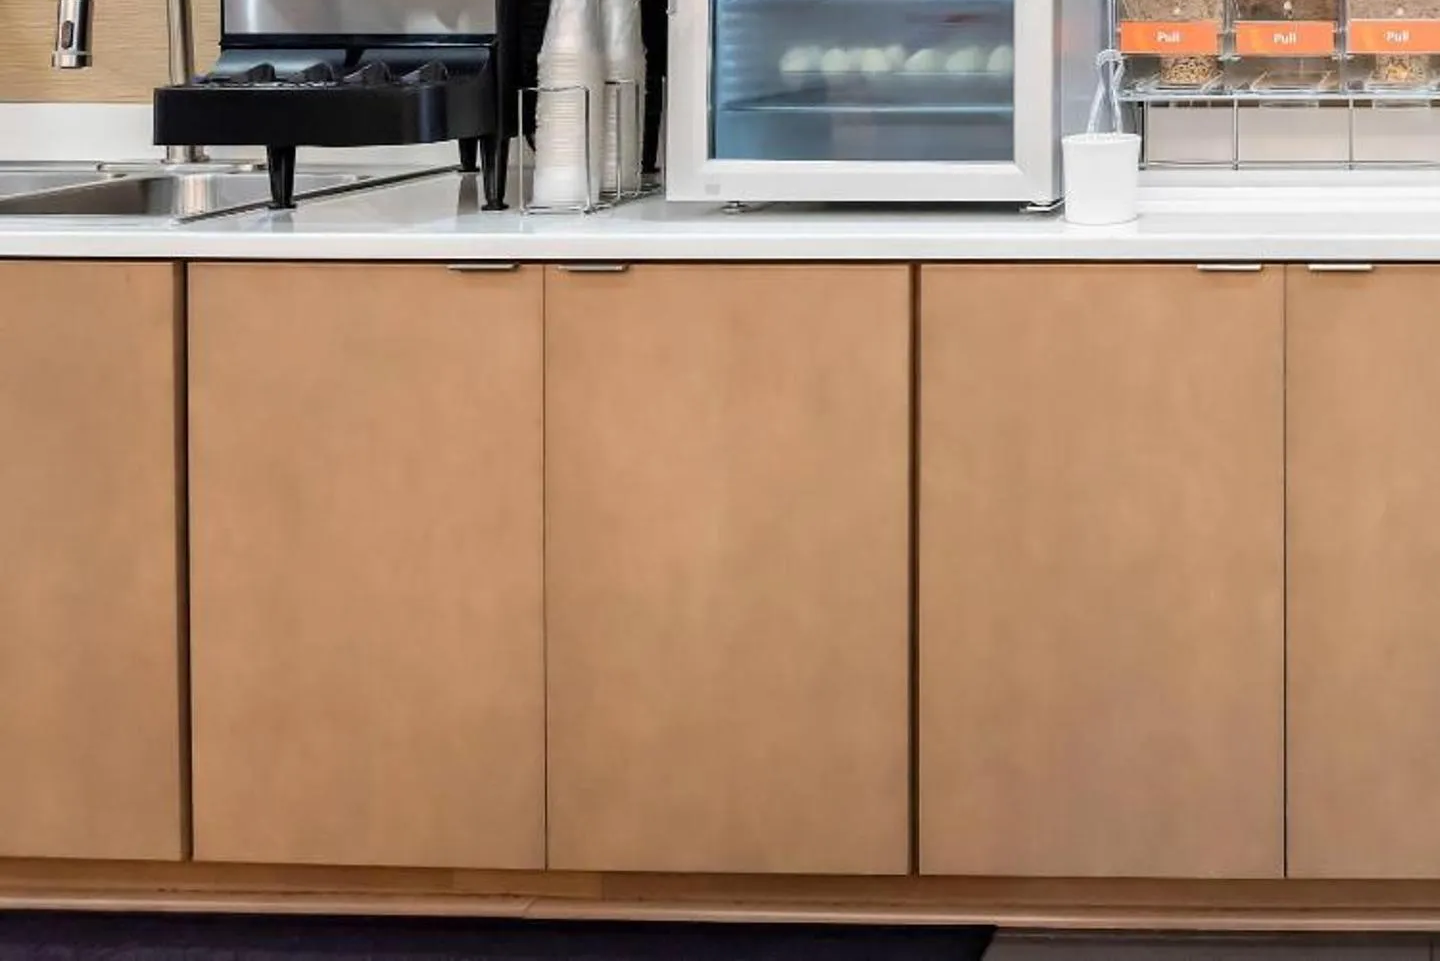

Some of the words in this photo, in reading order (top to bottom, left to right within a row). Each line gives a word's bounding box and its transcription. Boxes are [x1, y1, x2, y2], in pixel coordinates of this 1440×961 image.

[1156, 30, 1181, 43] Pull
[1273, 32, 1297, 45] Pull
[1386, 30, 1410, 43] Pull
